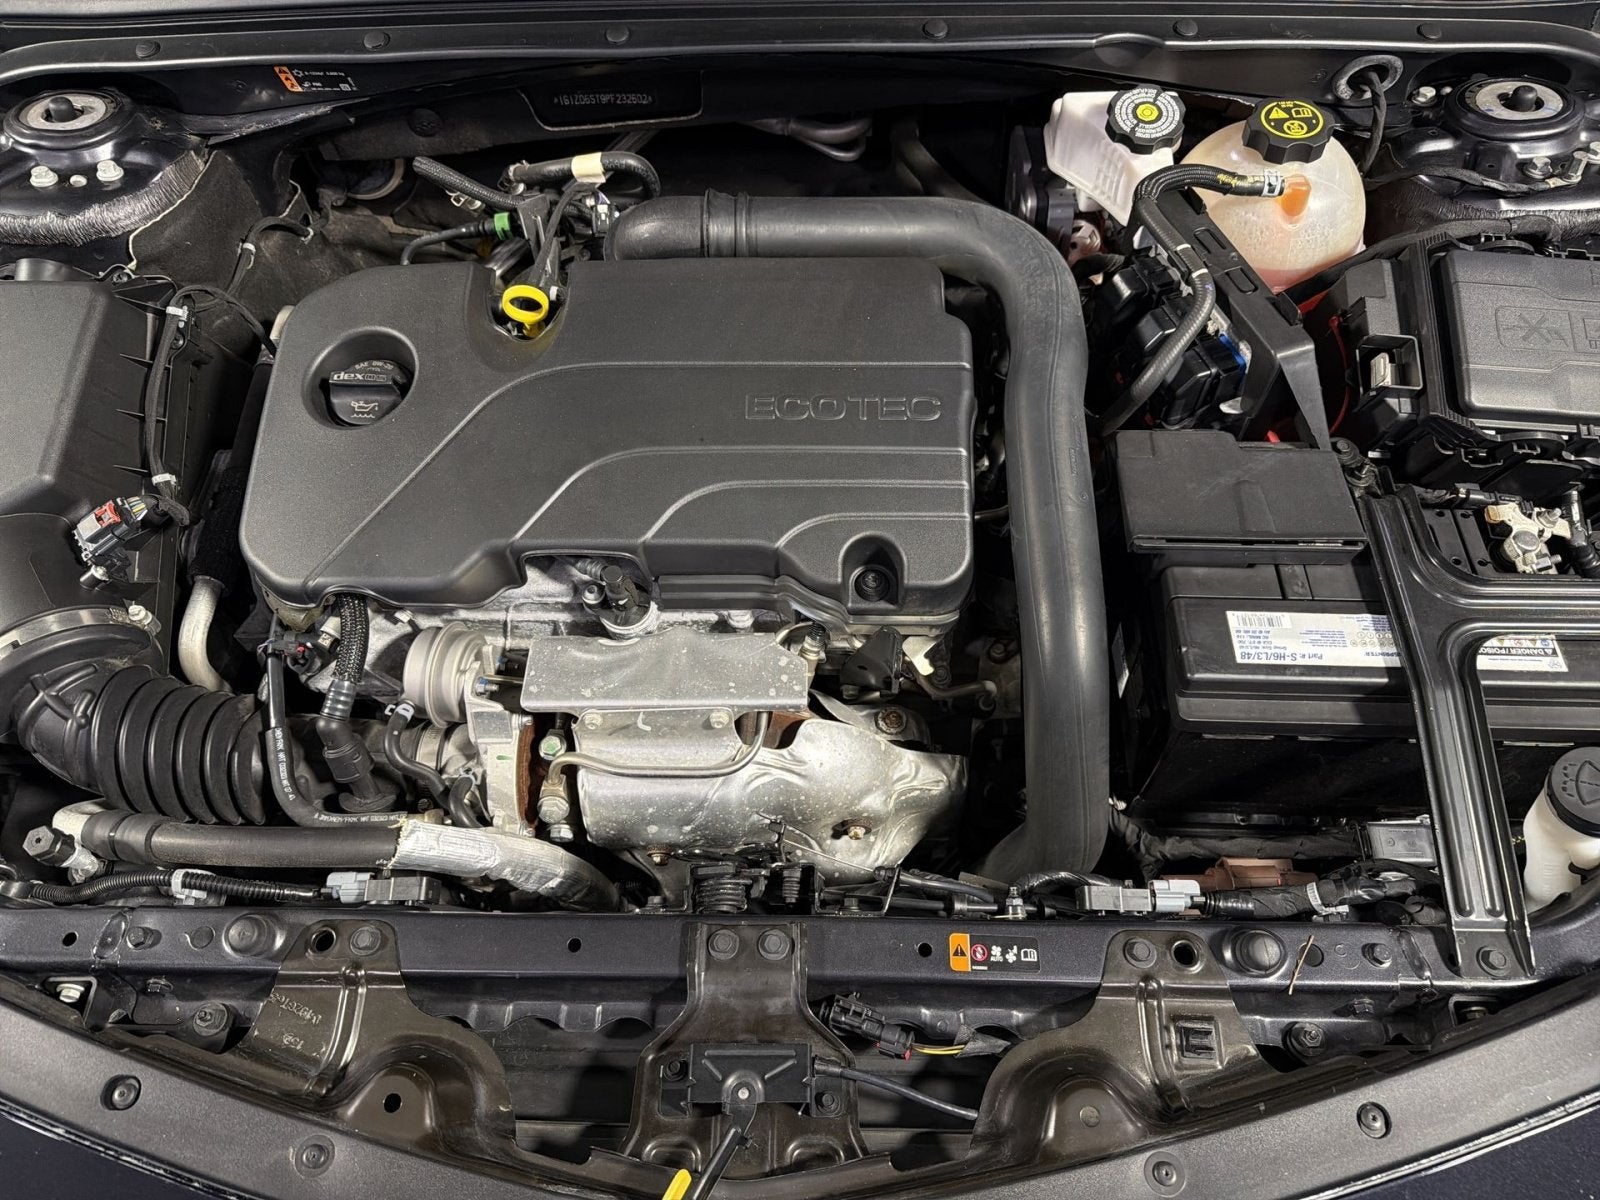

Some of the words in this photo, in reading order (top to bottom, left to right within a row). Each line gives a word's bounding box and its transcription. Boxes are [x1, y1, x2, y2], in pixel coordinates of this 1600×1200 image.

[333, 371, 387, 382] dexos
[745, 395, 942, 421] ECOTEC
[1240, 651, 1297, 662] S-H6/L3/48
[1308, 652, 1323, 660] Part
[1510, 647, 1545, 656] DANGER
